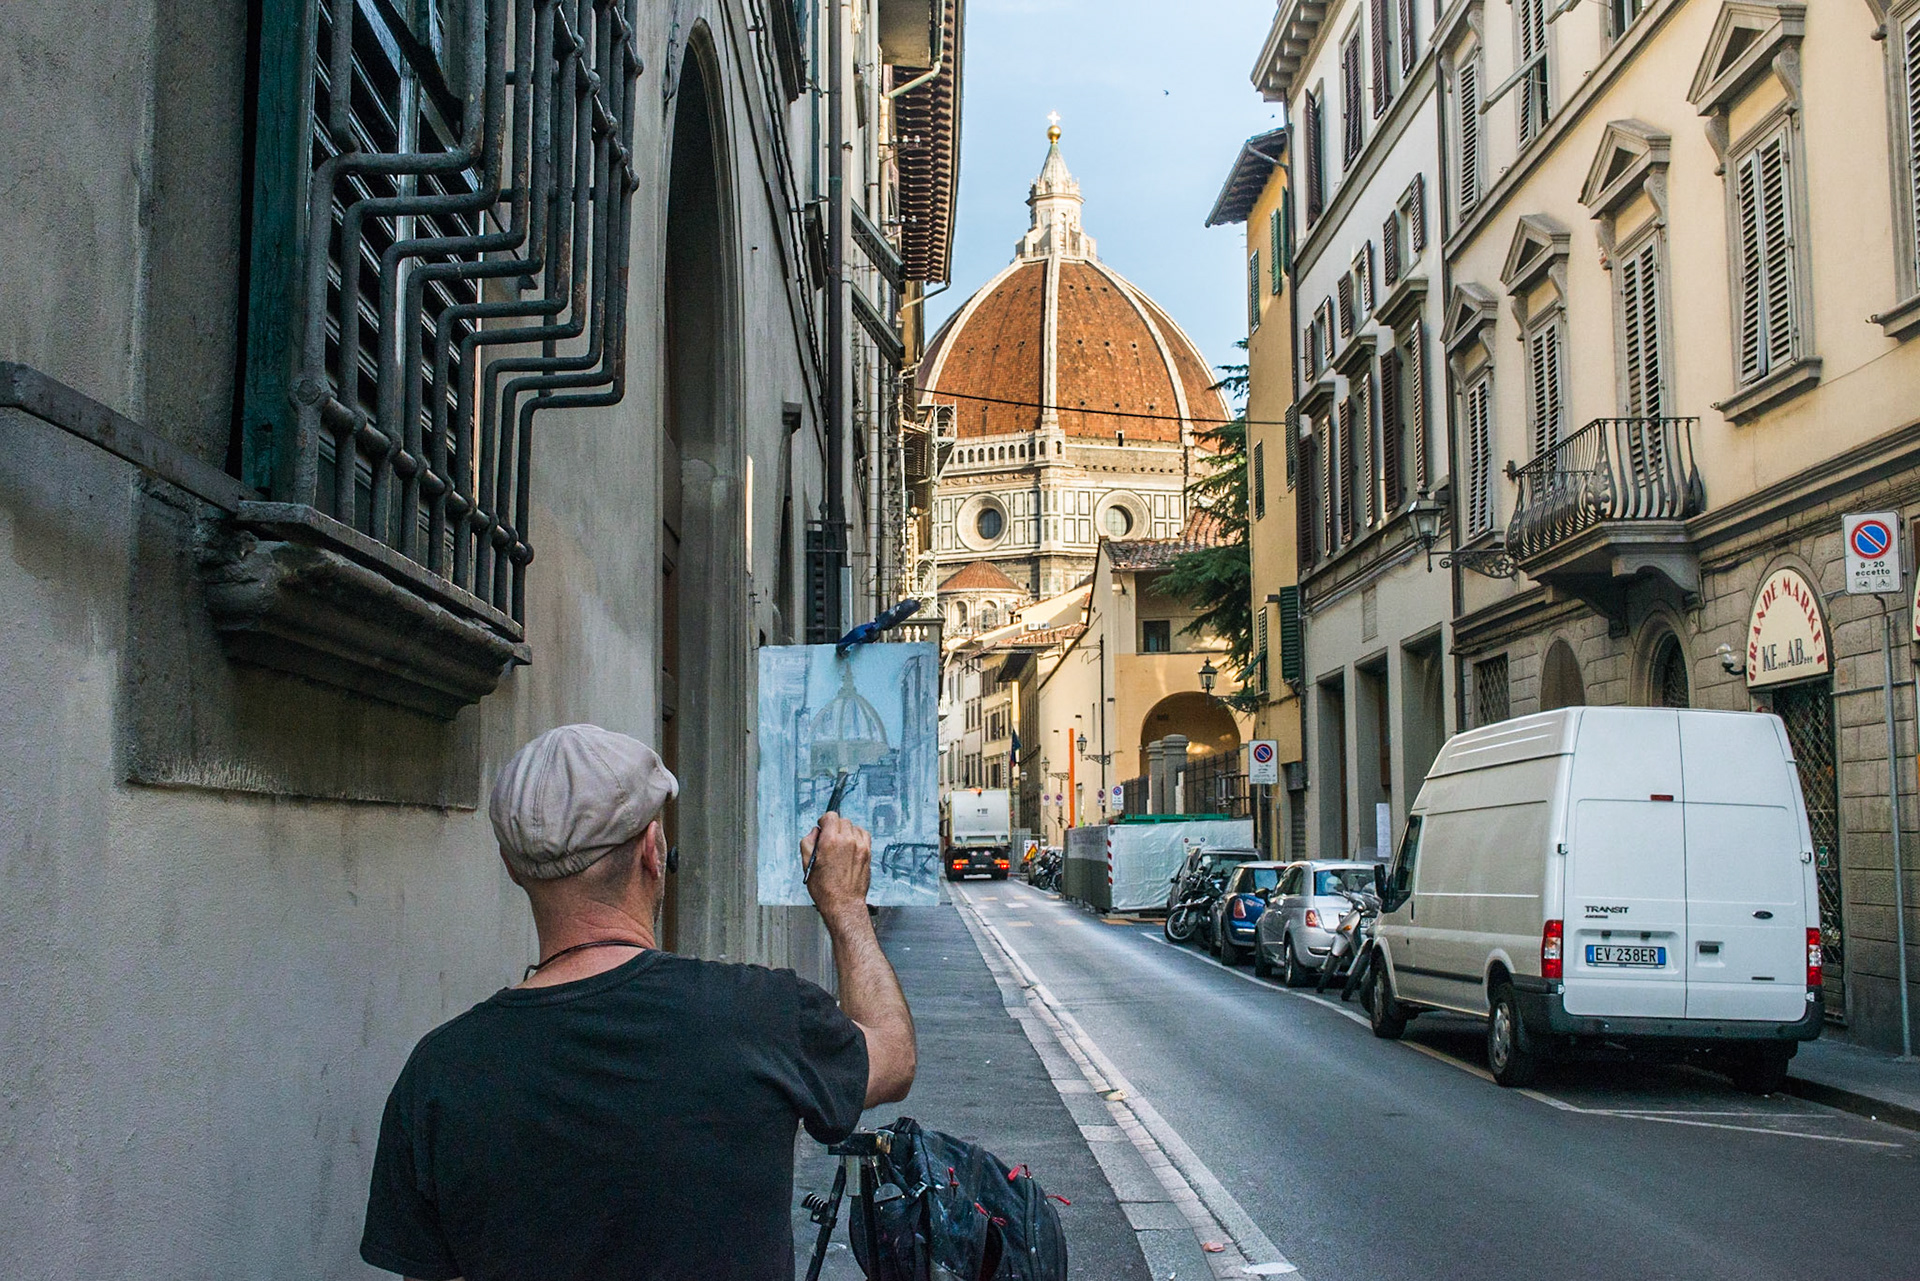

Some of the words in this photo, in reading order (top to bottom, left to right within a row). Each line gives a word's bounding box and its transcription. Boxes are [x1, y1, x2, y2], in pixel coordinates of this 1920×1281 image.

[1860, 561, 1866, 569] 8
[1873, 560, 1885, 568] 20
[1855, 568, 1891, 577] eccetto
[1748, 580, 1779, 682] GRANDE
[1781, 577, 1826, 665] MARKET
[1584, 905, 1630, 914] TRANSIT
[1595, 947, 1611, 962] EV
[1616, 948, 1657, 963] 238ER
